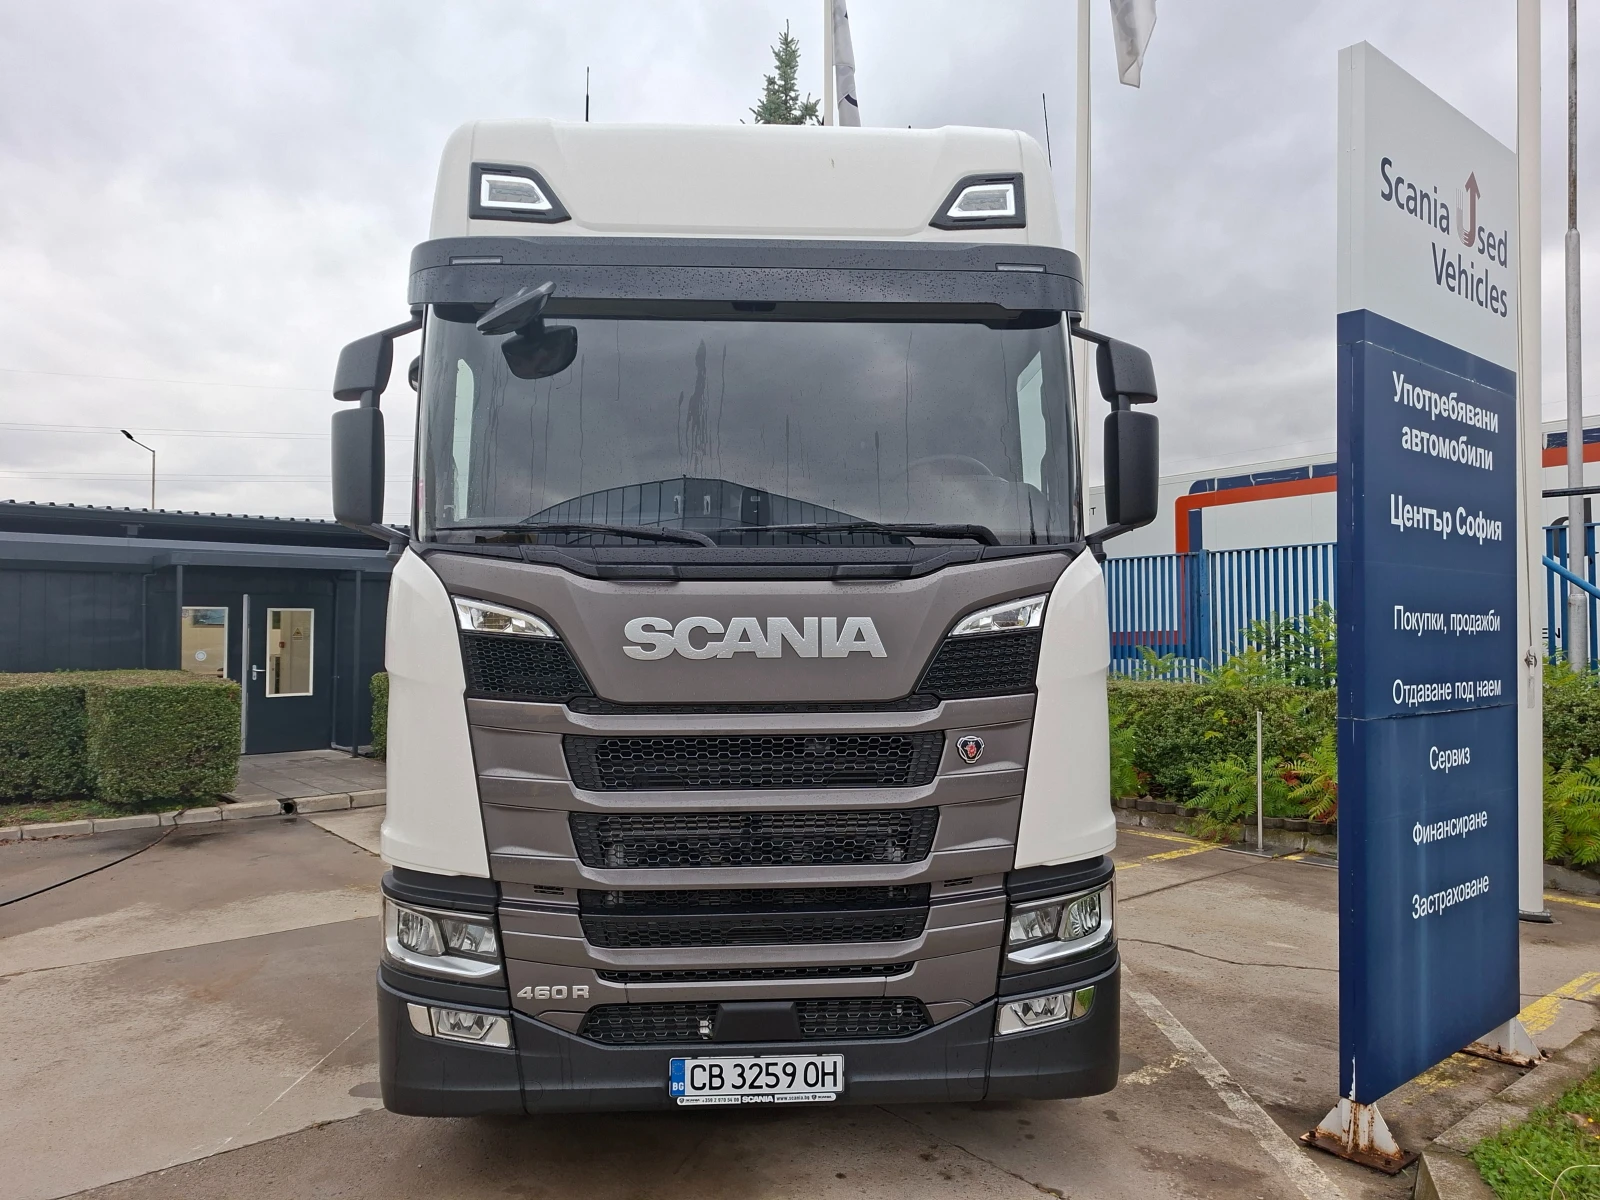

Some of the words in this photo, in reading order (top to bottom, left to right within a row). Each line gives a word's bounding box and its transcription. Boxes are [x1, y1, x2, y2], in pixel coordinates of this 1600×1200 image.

[1380, 156, 1450, 236] Scania
[1456, 171, 1508, 269] Used
[1431, 241, 1508, 318] Vehicles
[1392, 370, 1499, 434] Употребявани
[1401, 425, 1493, 471] автомобили
[1390, 493, 1452, 540] Център
[1455, 506, 1502, 545] София
[622, 616, 888, 661] SCANIA
[1394, 605, 1447, 637] Покупки,
[1450, 609, 1501, 636] продажби
[1392, 679, 1452, 707] Отдаване
[1454, 682, 1475, 702] под
[1476, 679, 1502, 698] наем
[1429, 745, 1471, 773] Сервиз
[1412, 810, 1488, 846] Финансиране
[1412, 875, 1490, 919] Застраховане
[516, 985, 568, 1000] 460
[572, 985, 590, 999] R
[672, 1081, 685, 1091] BG
[690, 1063, 725, 1091] CB
[731, 1062, 797, 1090] 3259
[741, 1094, 774, 1103] SCANIA
